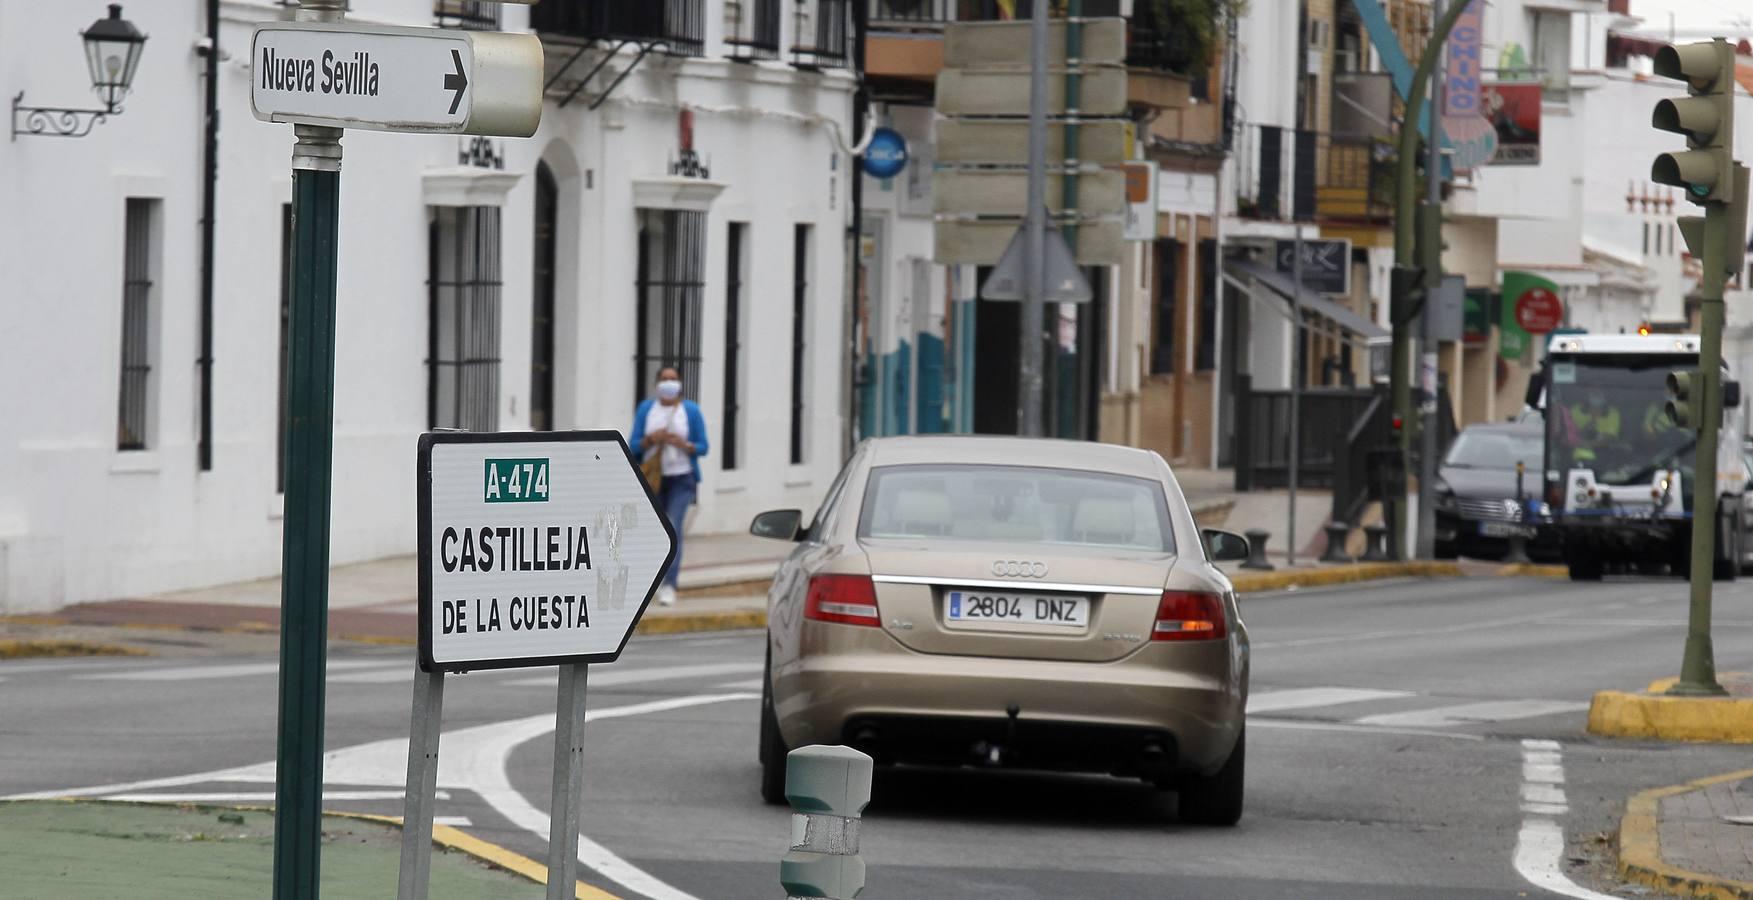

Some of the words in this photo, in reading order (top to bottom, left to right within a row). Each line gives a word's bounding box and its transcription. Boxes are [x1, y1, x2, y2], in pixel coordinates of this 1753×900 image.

[262, 47, 315, 93] Nueva
[321, 49, 379, 96] Sevilla
[1451, 27, 1479, 109] CHINO
[486, 462, 548, 499] A-474
[441, 526, 592, 573] CASTILLEJA
[442, 599, 467, 634] DE
[476, 598, 501, 632] LA
[509, 595, 590, 631] CUESTA
[967, 596, 1022, 619] 2804
[1035, 599, 1078, 621] DNZ
